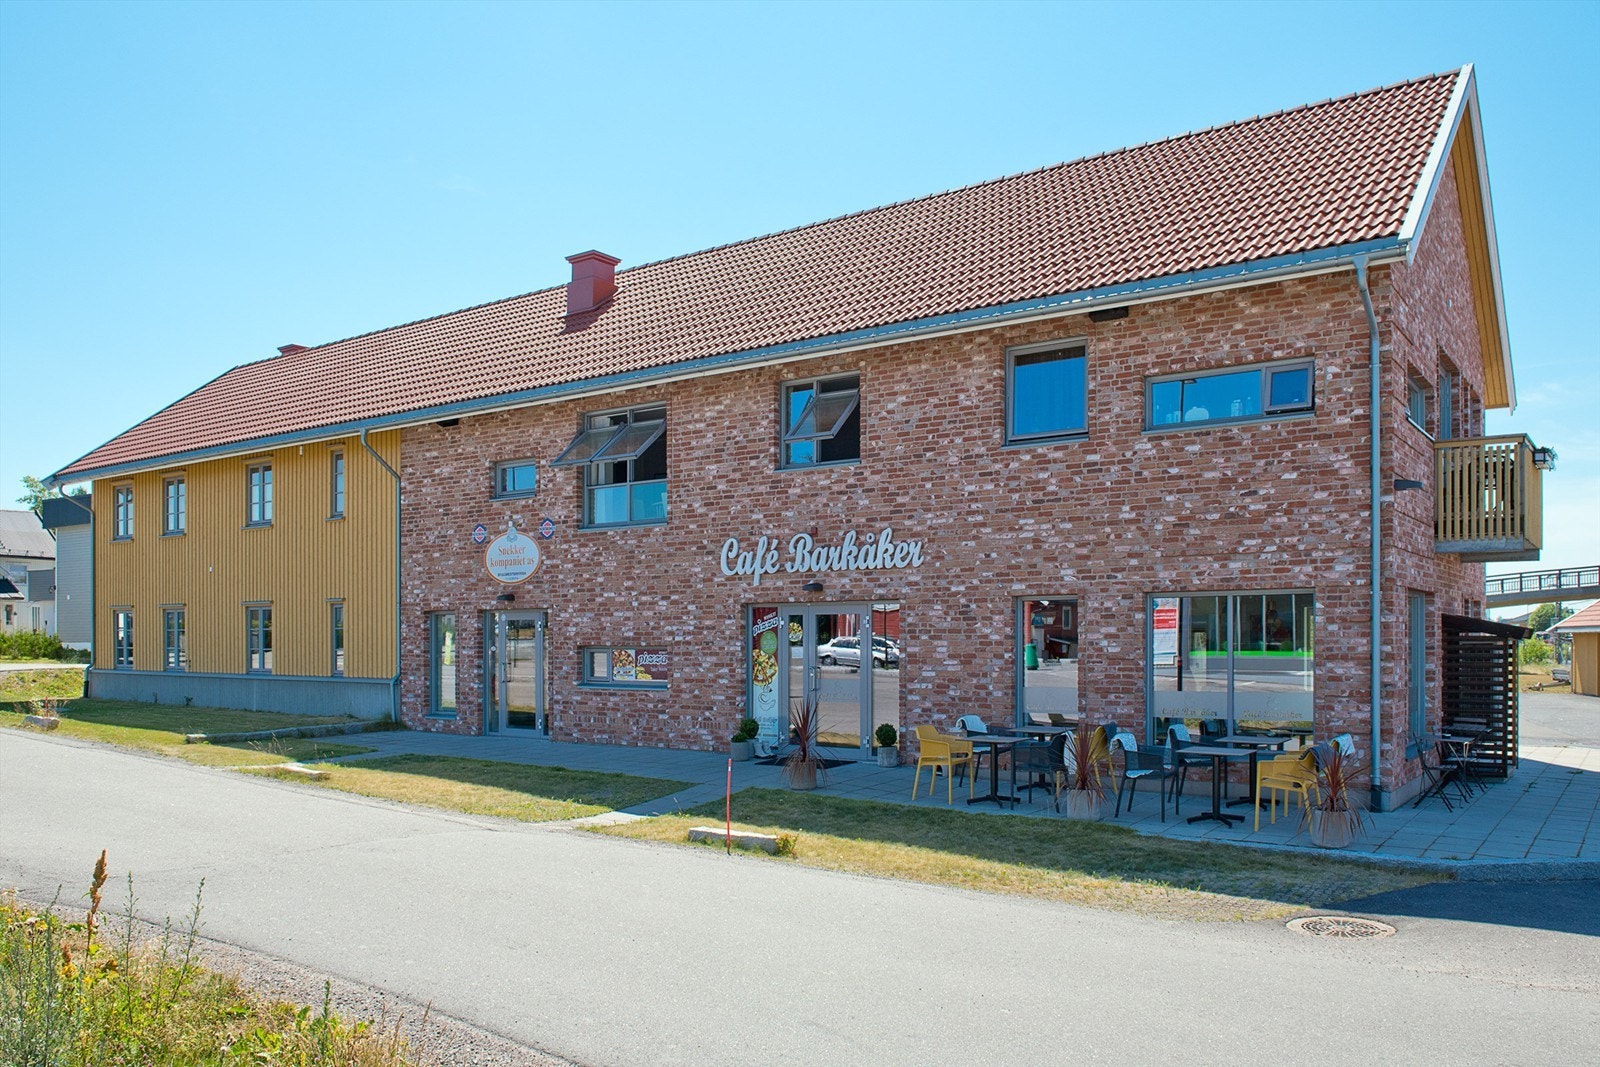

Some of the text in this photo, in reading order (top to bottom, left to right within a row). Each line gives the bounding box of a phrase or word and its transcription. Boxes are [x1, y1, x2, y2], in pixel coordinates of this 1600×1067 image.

[498, 544, 527, 556] Snekker
[720, 527, 925, 586] Café Barkåker
[490, 555, 526, 570] kompaniet
